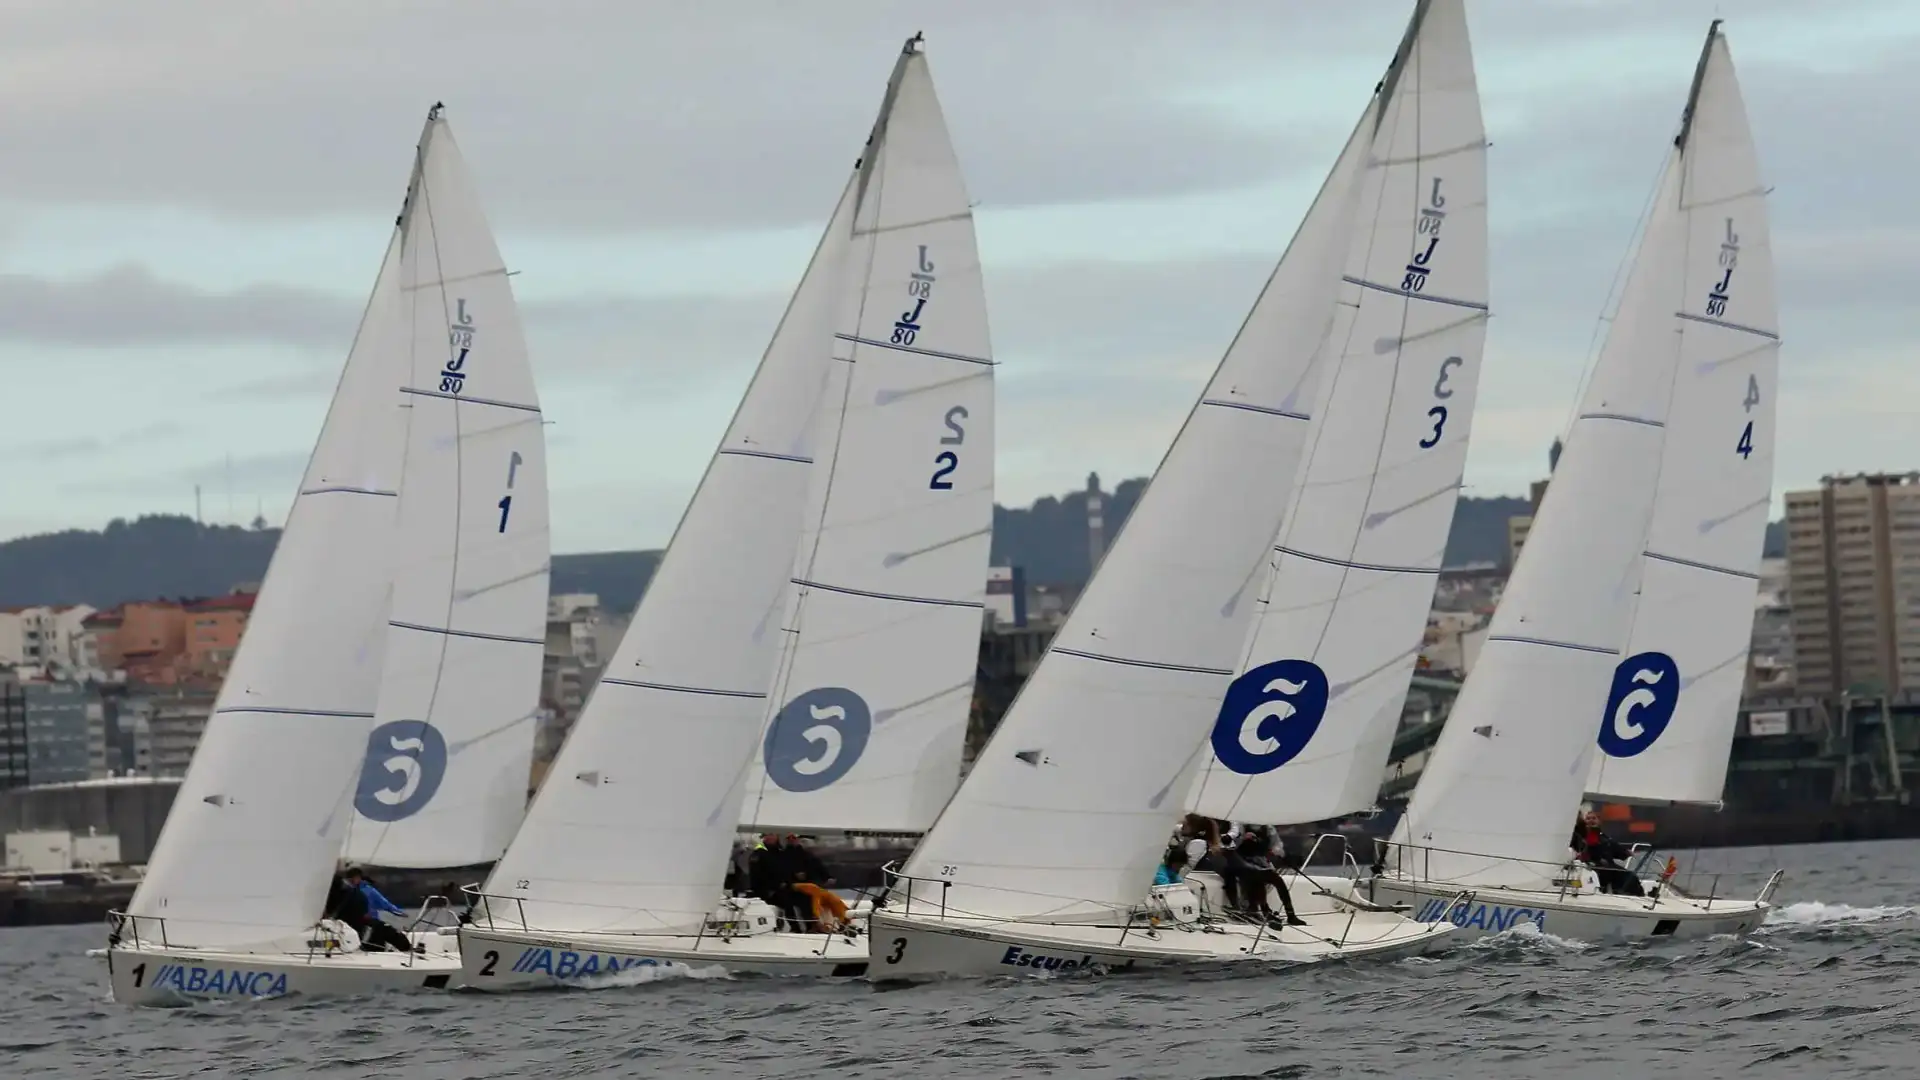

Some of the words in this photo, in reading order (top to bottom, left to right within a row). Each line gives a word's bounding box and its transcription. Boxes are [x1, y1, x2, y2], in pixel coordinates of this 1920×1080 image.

[1414, 238, 1439, 265] J
[1401, 273, 1425, 292] 80
[1715, 268, 1732, 293] J
[902, 298, 927, 323] J
[1706, 300, 1725, 317] 80
[890, 327, 916, 346] 80
[446, 347, 469, 371] J
[439, 377, 463, 394] 80
[1419, 406, 1447, 449] 3
[1736, 420, 1754, 460] 4
[930, 451, 958, 490] 2
[498, 495, 512, 533] 1
[478, 950, 500, 977] 2
[886, 937, 908, 965] 3
[132, 962, 147, 988] 1
